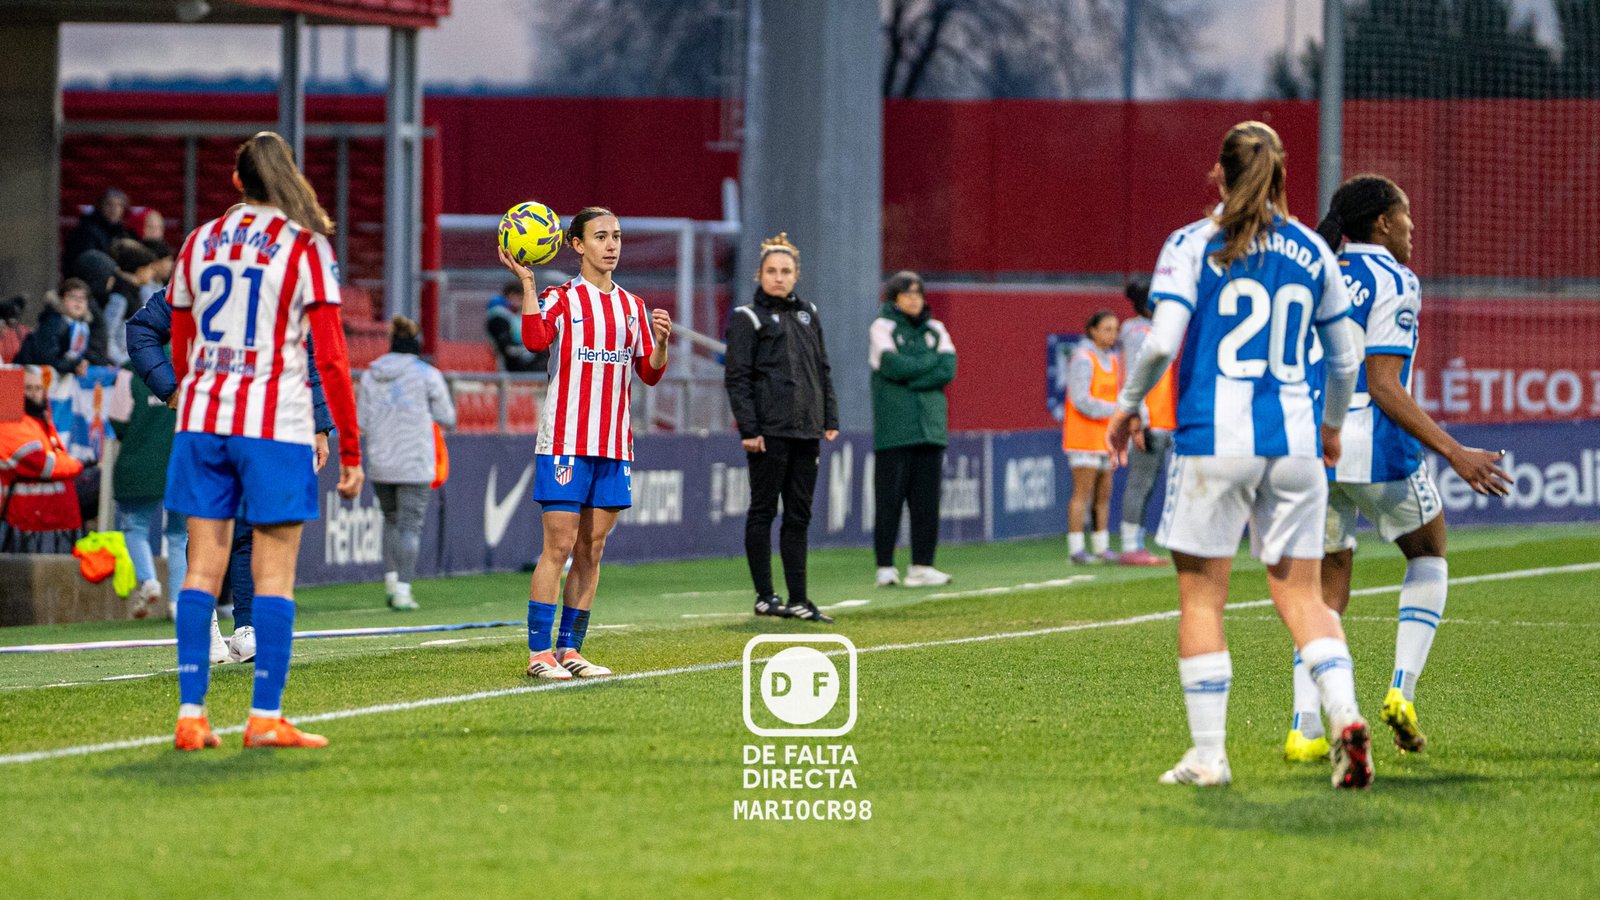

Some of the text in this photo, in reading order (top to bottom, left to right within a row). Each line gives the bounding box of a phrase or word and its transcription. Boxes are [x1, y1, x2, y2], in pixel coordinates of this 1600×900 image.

[203, 227, 281, 258] FIAMMA
[200, 265, 263, 346] 21
[1218, 278, 1314, 383] 20
